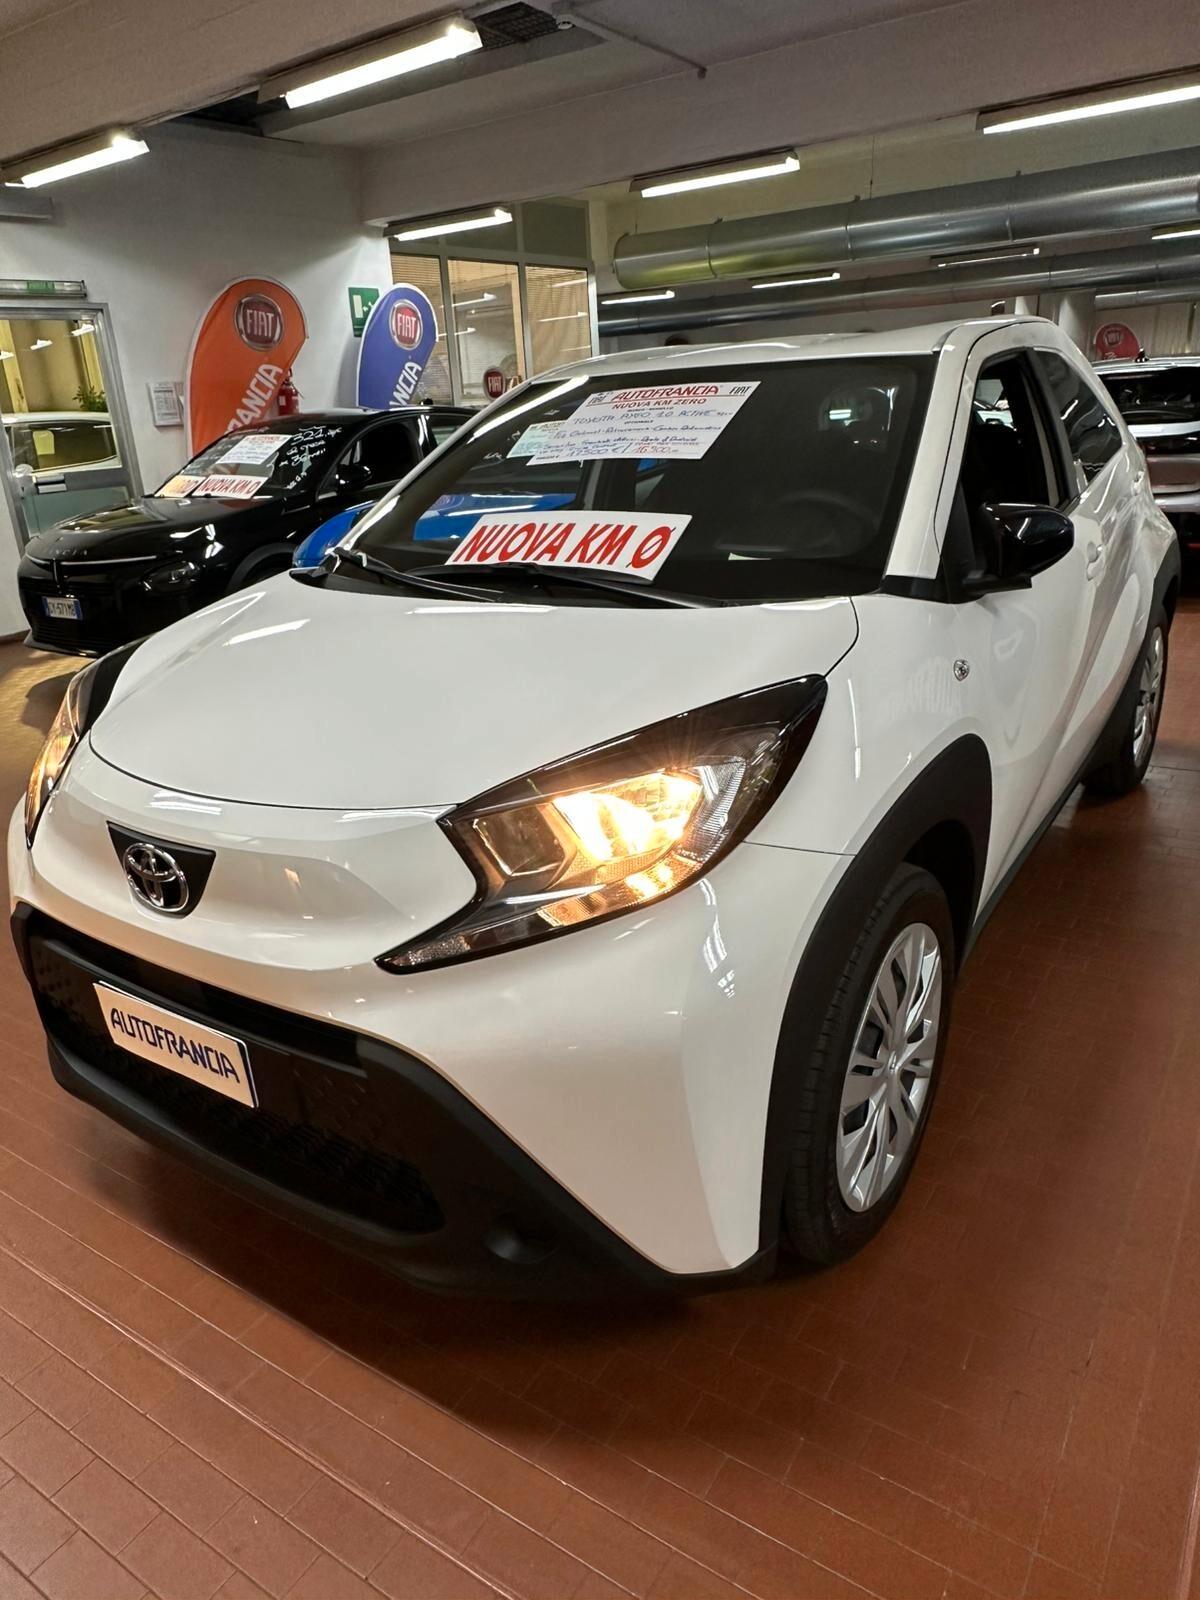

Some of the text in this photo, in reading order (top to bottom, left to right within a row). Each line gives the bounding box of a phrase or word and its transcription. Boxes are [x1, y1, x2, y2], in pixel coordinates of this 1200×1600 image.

[246, 309, 275, 337] FIAT
[396, 313, 417, 338] FIAT
[389, 361, 422, 408] NCIA
[612, 385, 720, 400] AUTOFRANCIA
[729, 385, 752, 396] FIAT
[612, 399, 652, 410] NUOVA
[652, 399, 673, 407] KM
[672, 397, 707, 406] ZERO
[198, 476, 234, 493] NUOVA
[453, 522, 576, 562] NUOVA
[564, 523, 638, 566] KM
[111, 1007, 240, 1084] AUTOFRANCIA
